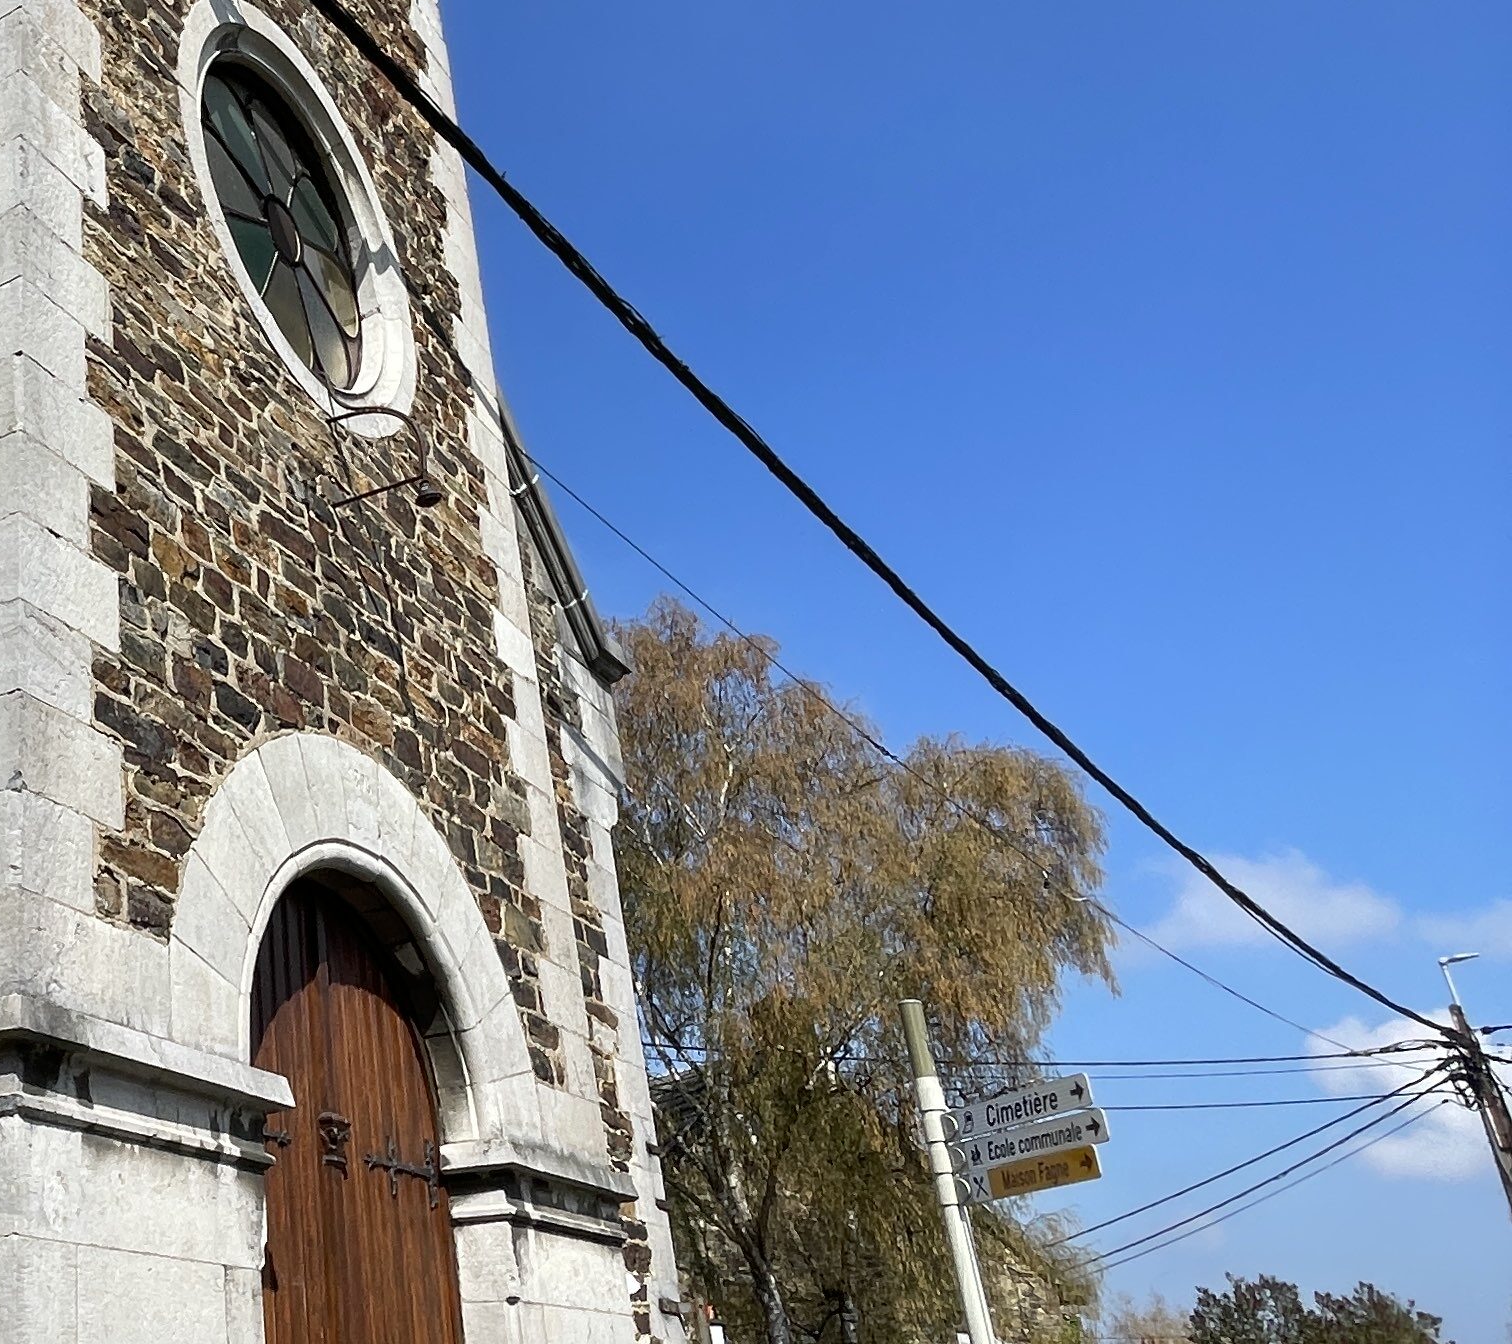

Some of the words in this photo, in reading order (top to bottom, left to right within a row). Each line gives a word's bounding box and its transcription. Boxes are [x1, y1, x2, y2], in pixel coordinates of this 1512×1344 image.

[986, 1091, 1058, 1127] Cimetière
[987, 1139, 1016, 1161] Ecole
[1018, 1122, 1083, 1153] communale
